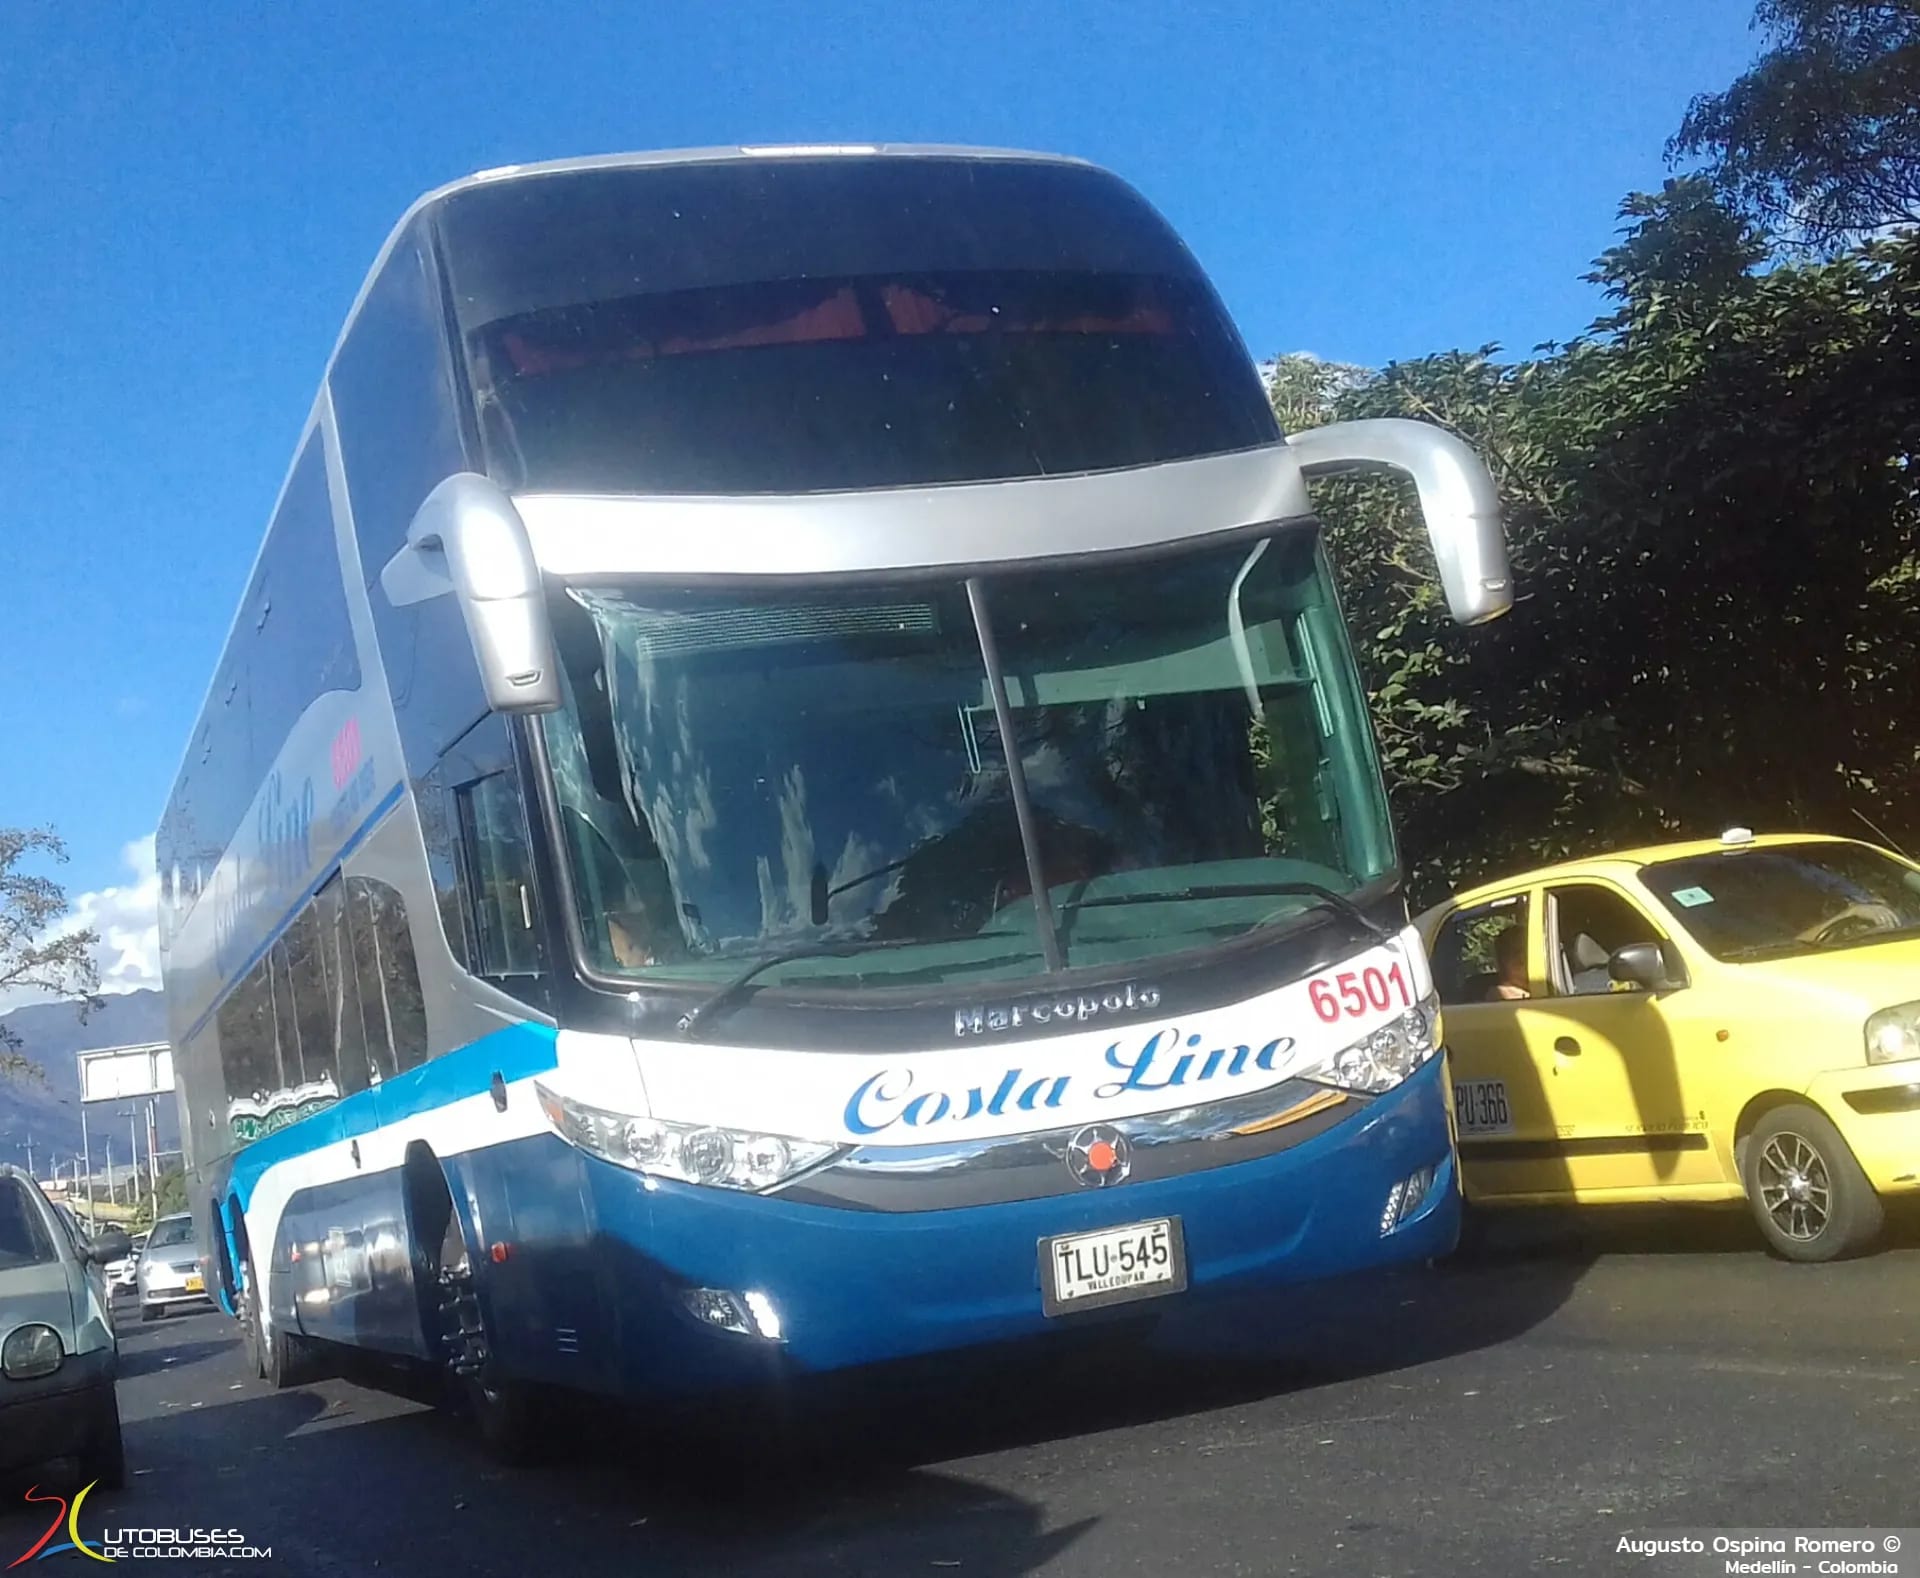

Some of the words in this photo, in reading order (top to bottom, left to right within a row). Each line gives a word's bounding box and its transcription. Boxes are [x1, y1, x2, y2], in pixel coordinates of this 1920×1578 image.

[954, 983, 1161, 1037] Marcopolo
[1308, 961, 1413, 1024] 6501
[843, 1066, 1073, 1136] Costa
[1092, 1027, 1297, 1099] Line
[1456, 1083, 1508, 1125] PU·366
[1087, 1270, 1146, 1292] VALLEDUPAR
